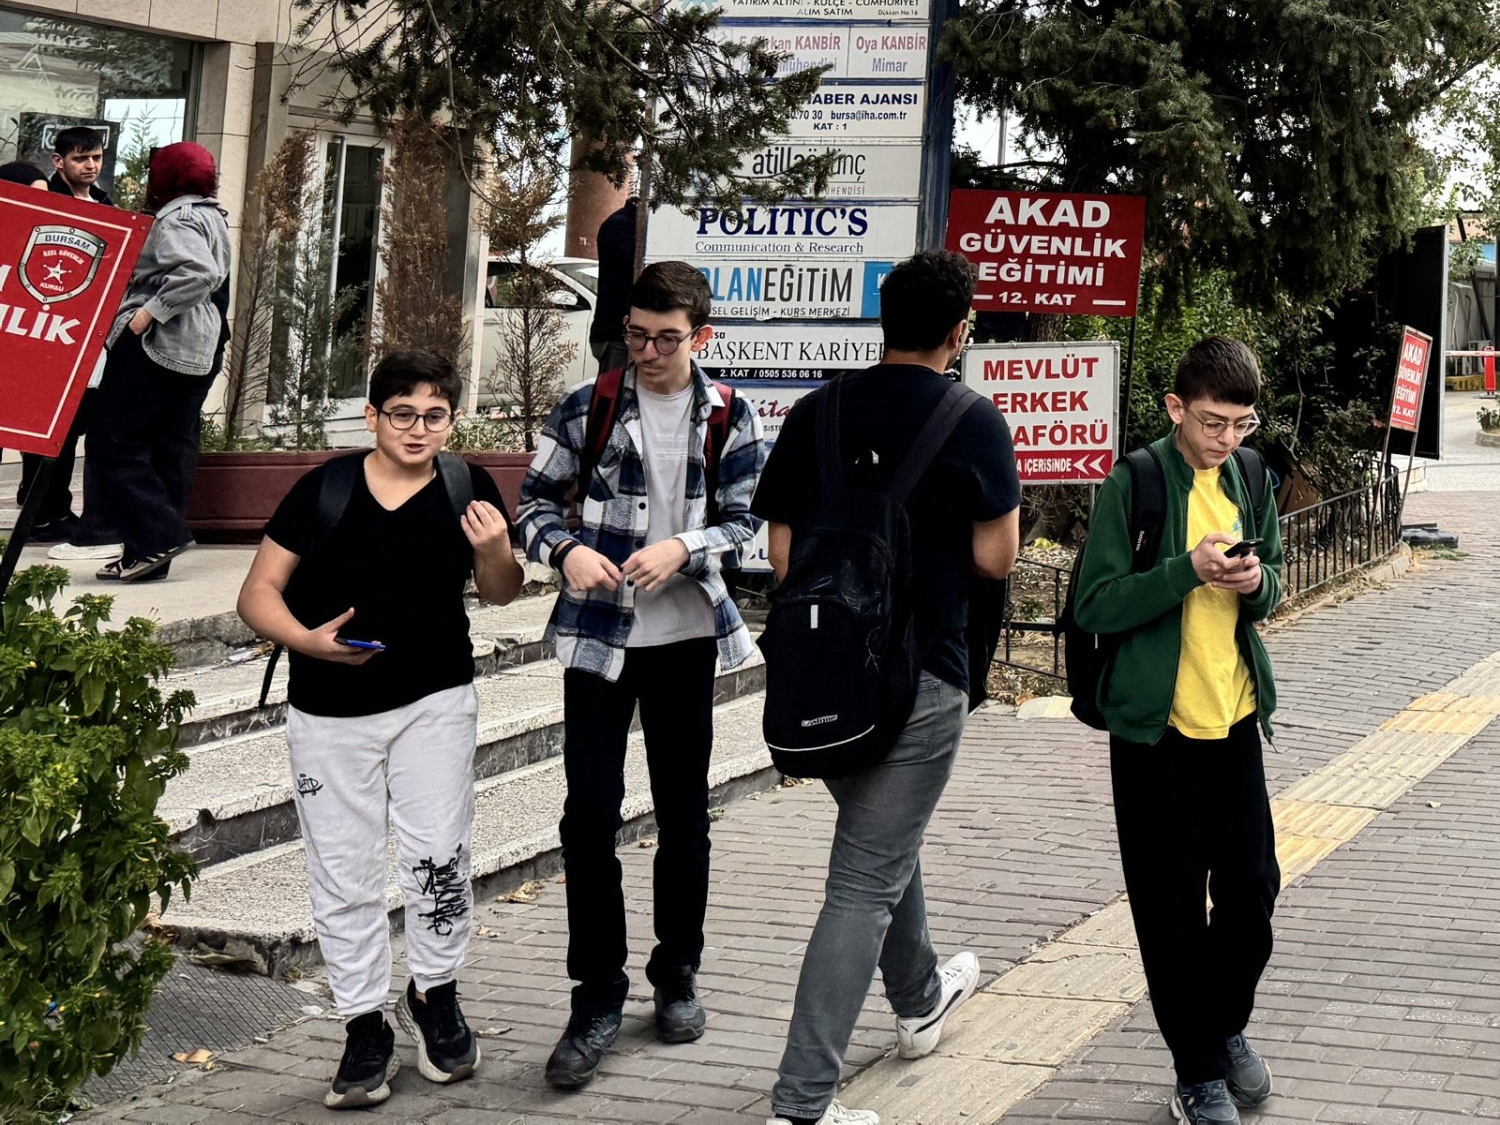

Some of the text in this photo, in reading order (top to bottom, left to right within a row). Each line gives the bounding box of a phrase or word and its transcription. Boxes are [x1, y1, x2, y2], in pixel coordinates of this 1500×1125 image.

[796, 8, 853, 16] ALIM SATIM
[794, 32, 841, 50] KANBİR
[855, 32, 927, 54] Oya KANBİR
[871, 57, 908, 72] Mimar
[859, 93, 918, 105] AJANSI
[811, 109, 823, 120] 30
[830, 109, 907, 122] bursa@iha.com.tr
[813, 122, 833, 131] KAT
[984, 196, 1111, 228] AKAD
[695, 241, 864, 253] Communication & Research
[959, 228, 1128, 259] GÜVENLİK
[978, 257, 1105, 287] EĞİTİMİ
[998, 292, 1077, 306] 12. KAT
[730, 305, 770, 317] GELİŞİM
[780, 307, 806, 316] KURS
[808, 305, 851, 316] MERKEZİ
[697, 341, 794, 365] BAŞKENT
[1402, 342, 1424, 366] AKAD
[719, 369, 729, 378] 2.
[730, 369, 750, 378] KAT
[759, 369, 780, 378] 0505
[780, 369, 797, 379] 536
[798, 370, 811, 379] 06
[812, 370, 823, 379] 16
[983, 353, 1099, 381] MEVLÜT
[992, 390, 1089, 413] ERKEK
[1013, 419, 1108, 446] AFÖRÜ
